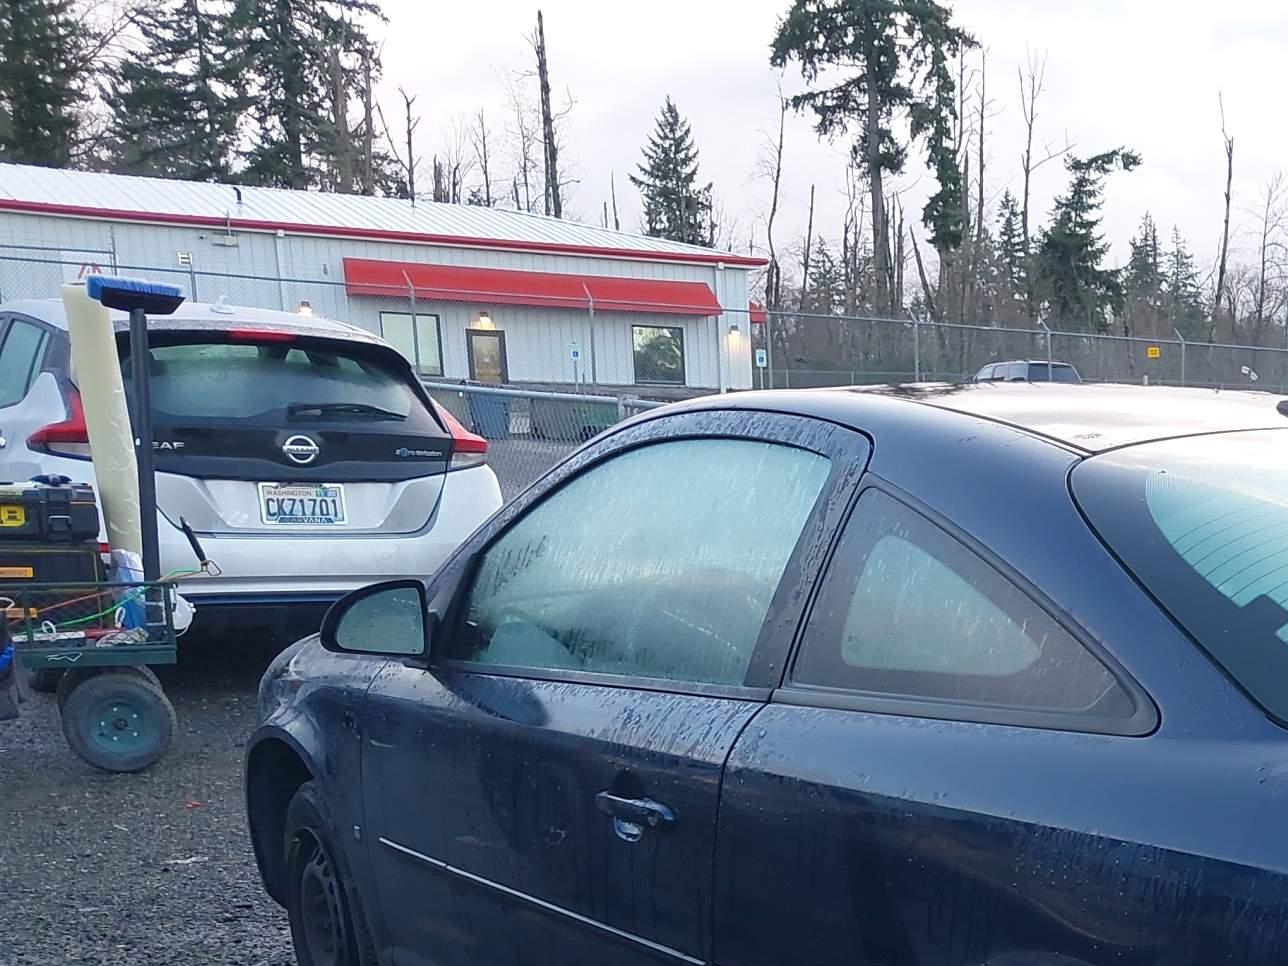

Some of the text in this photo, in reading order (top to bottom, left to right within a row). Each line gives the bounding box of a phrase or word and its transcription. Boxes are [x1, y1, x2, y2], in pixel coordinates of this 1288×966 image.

[151, 441, 185, 450] EAF
[266, 489, 312, 497] WASHINGTON
[266, 497, 338, 518] CKZ1701
